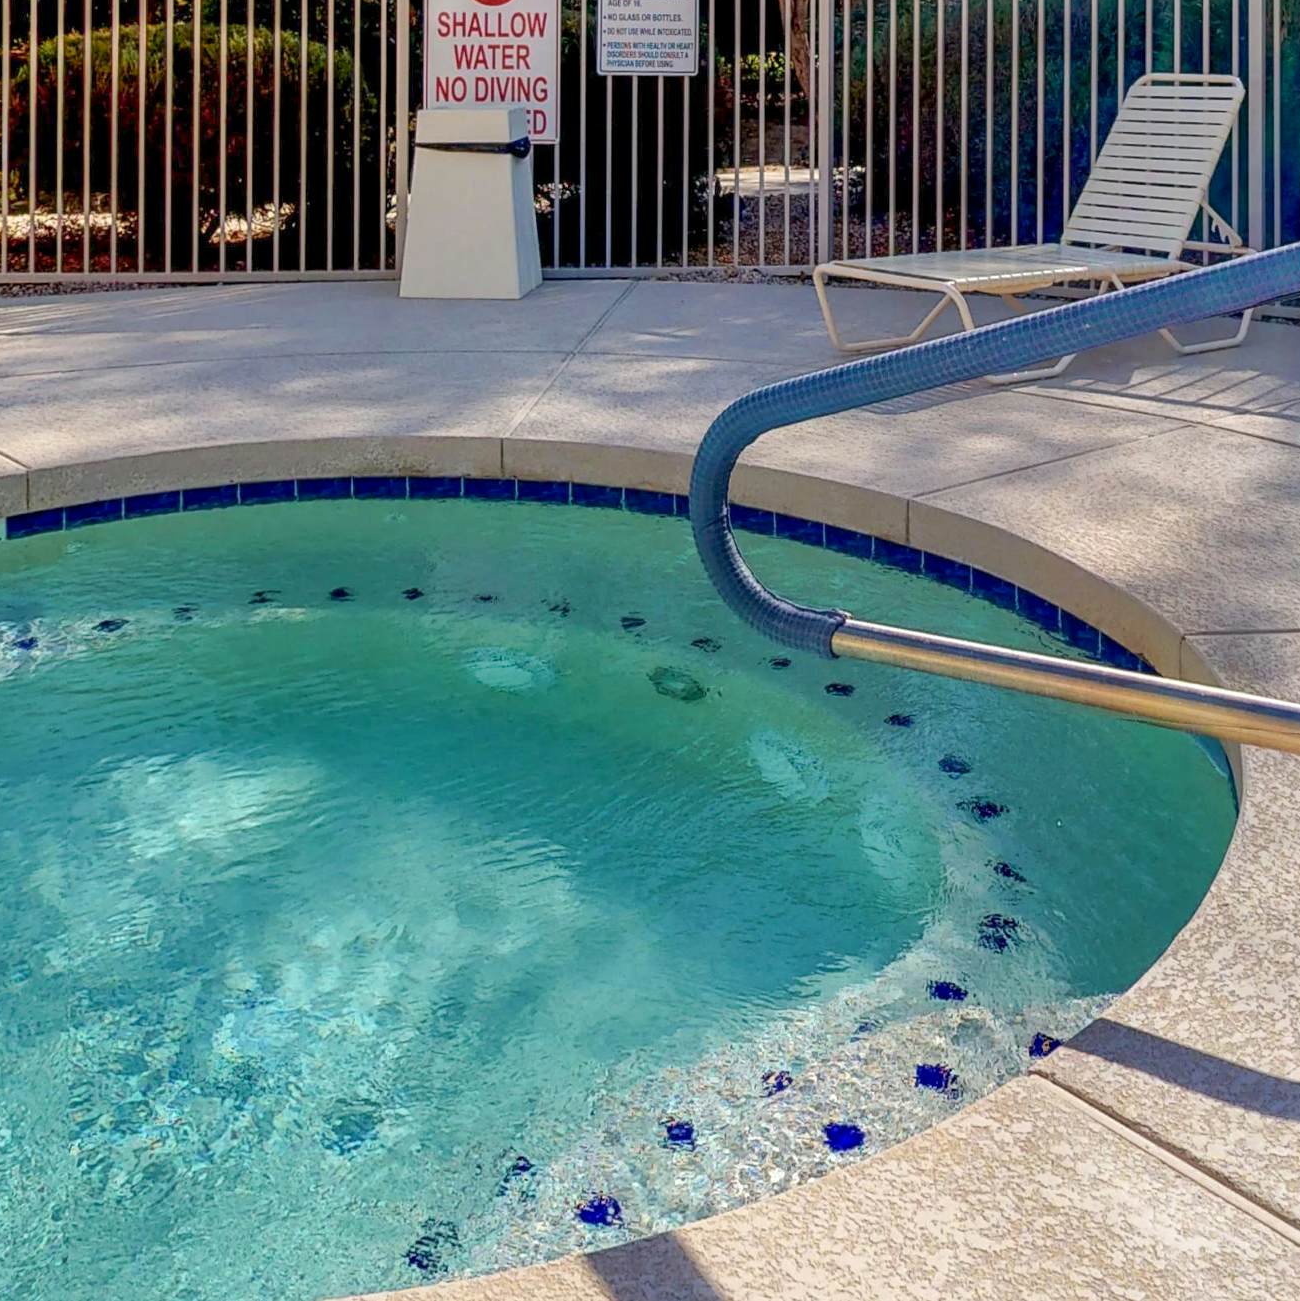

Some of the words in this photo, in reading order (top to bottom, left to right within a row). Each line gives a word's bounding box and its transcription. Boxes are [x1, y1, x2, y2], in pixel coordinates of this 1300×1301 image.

[607, 0, 621, 7] AGE
[623, 0, 632, 7] OF
[437, 11, 548, 38] SHALLOW
[607, 13, 617, 21] NO
[618, 13, 640, 21] GLASS
[607, 27, 615, 35] DO
[616, 27, 627, 35] NOT
[454, 44, 531, 70] WATER
[435, 76, 467, 102] NO
[474, 76, 548, 102] DIVING
